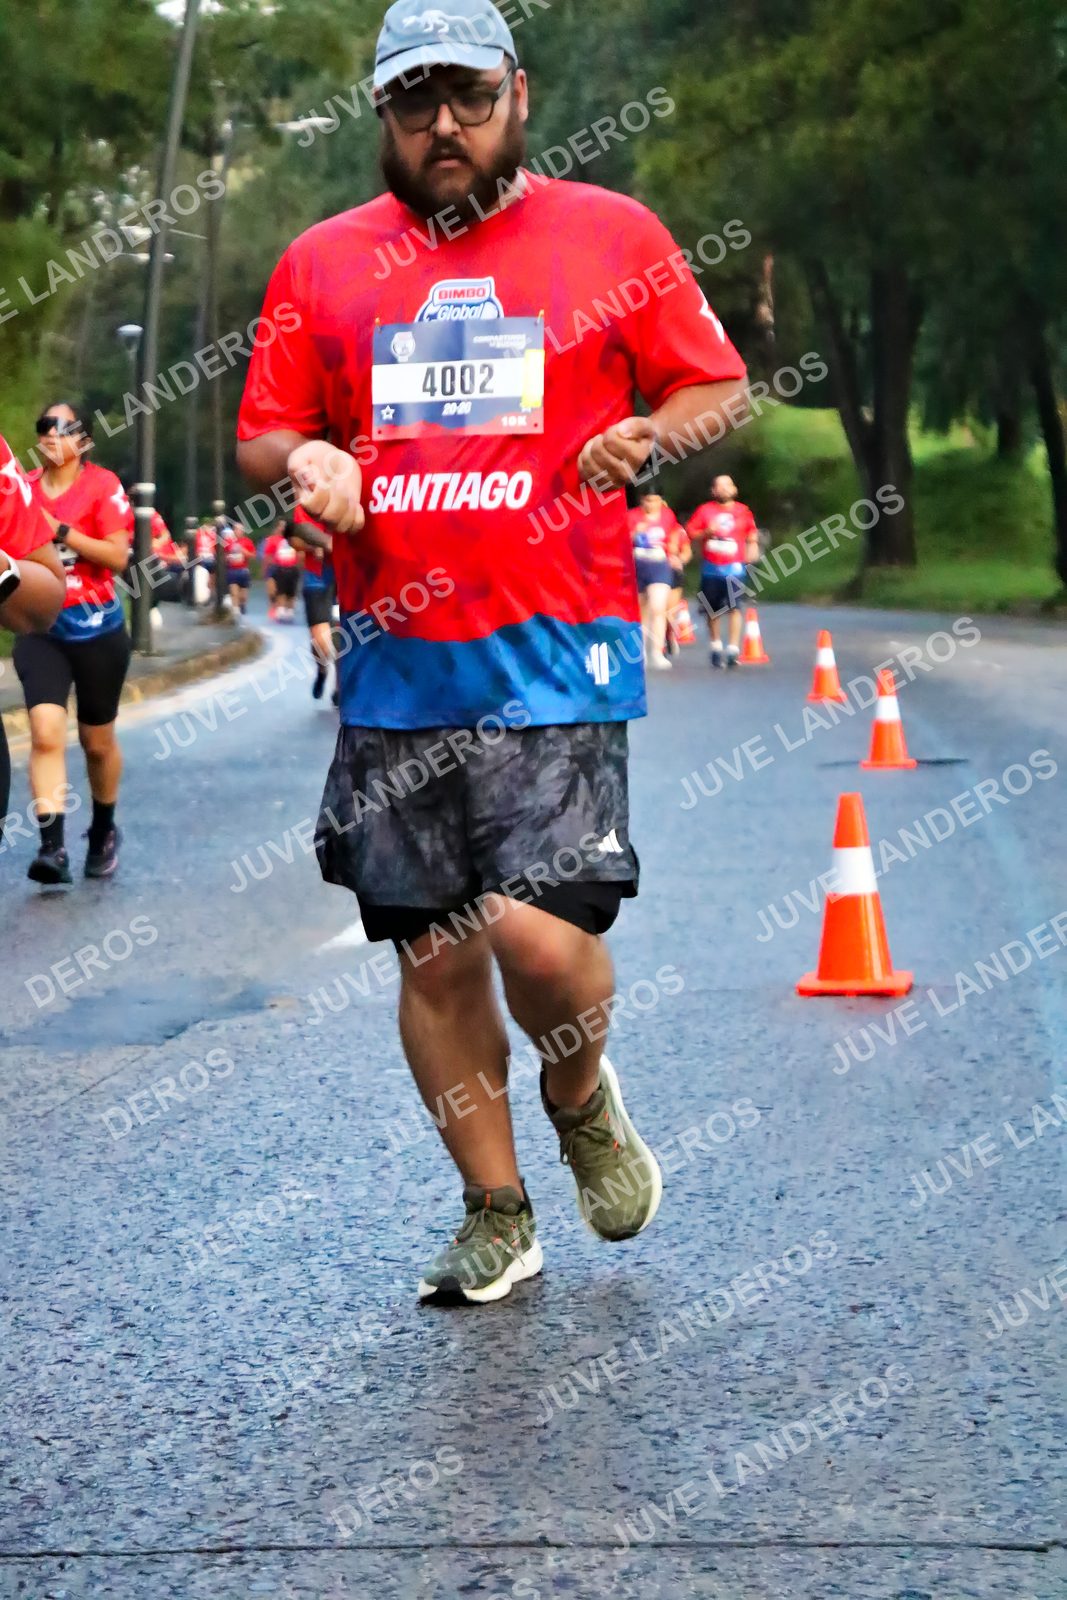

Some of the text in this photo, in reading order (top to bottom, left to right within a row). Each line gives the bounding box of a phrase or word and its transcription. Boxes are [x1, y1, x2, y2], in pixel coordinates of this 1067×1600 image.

[438, 287, 486, 300] BIMBO
[437, 302, 484, 321] Global
[422, 363, 494, 397] 4002
[501, 416, 527, 426] 10K
[369, 470, 533, 514] SANTIAGO
